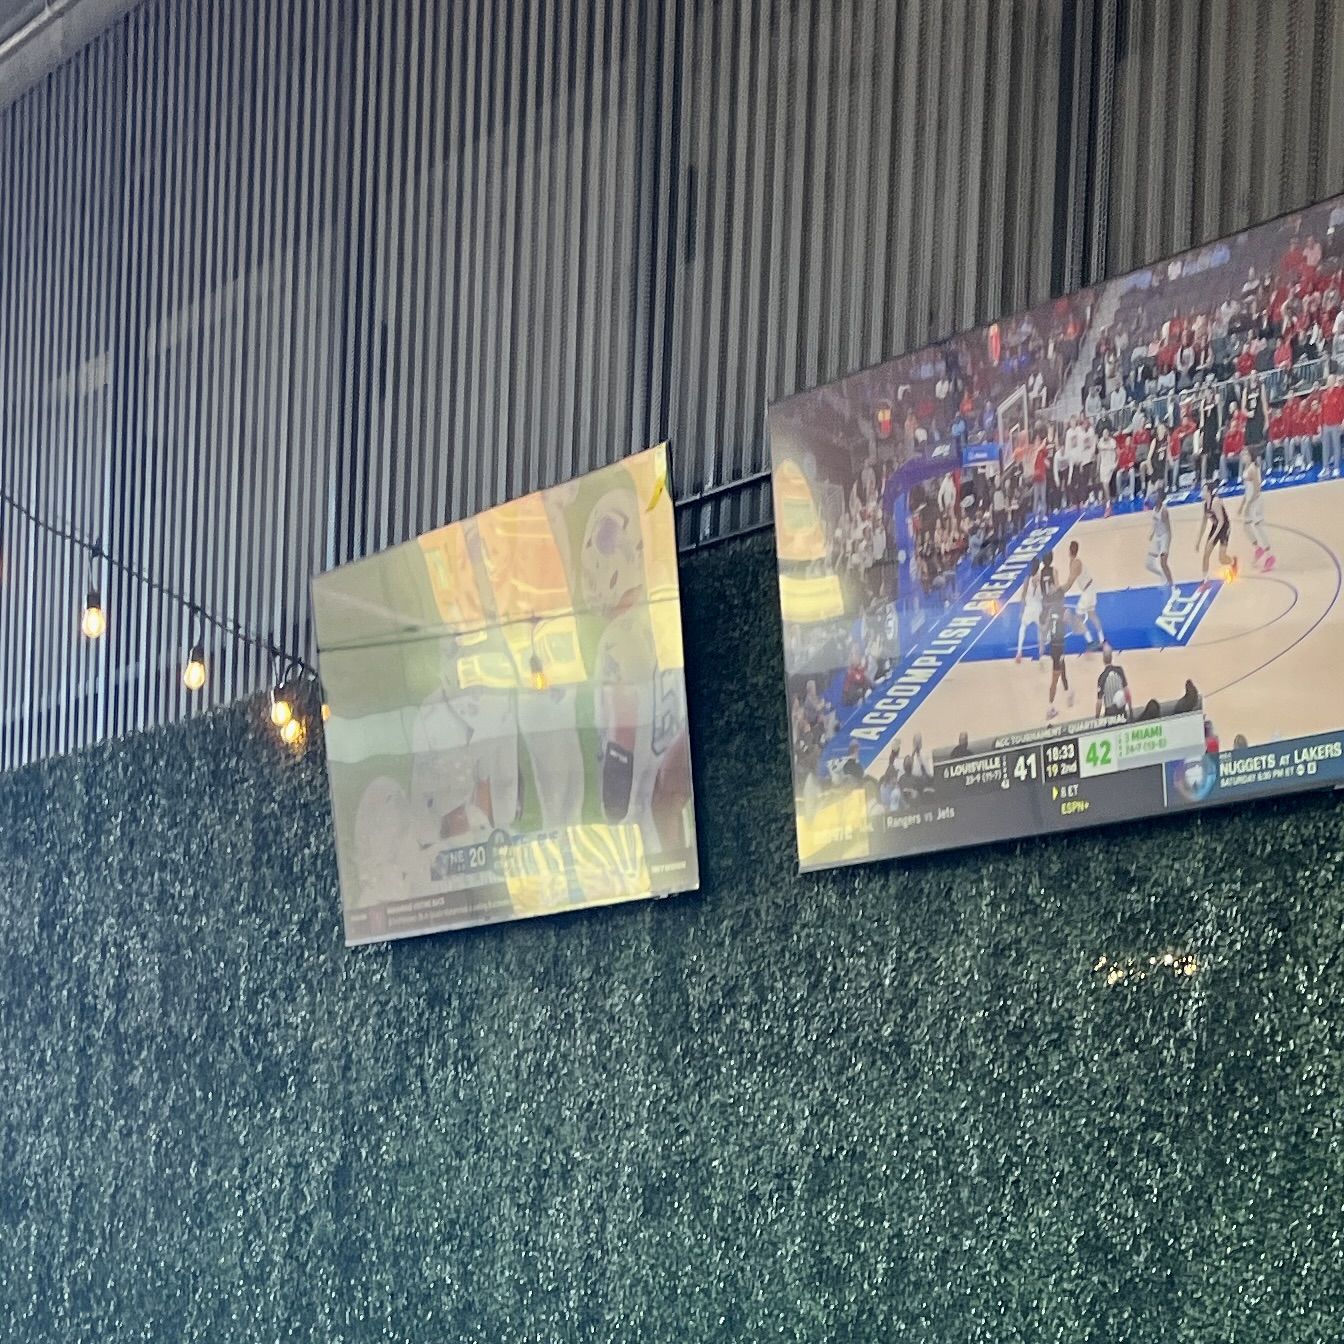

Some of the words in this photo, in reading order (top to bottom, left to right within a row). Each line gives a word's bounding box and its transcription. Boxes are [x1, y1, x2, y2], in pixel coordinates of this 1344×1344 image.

[850, 617, 981, 741] ACCOMPLISH
[1131, 725, 1162, 741] MIAMI
[1085, 740, 1112, 767] 42
[1219, 753, 1276, 777] NUGGETS
[1294, 741, 1342, 764] LAKERS
[950, 756, 1001, 778] LOUISVILLE
[1014, 753, 1037, 781] 41
[887, 814, 921, 829] Rangers
[469, 846, 486, 868] 20
